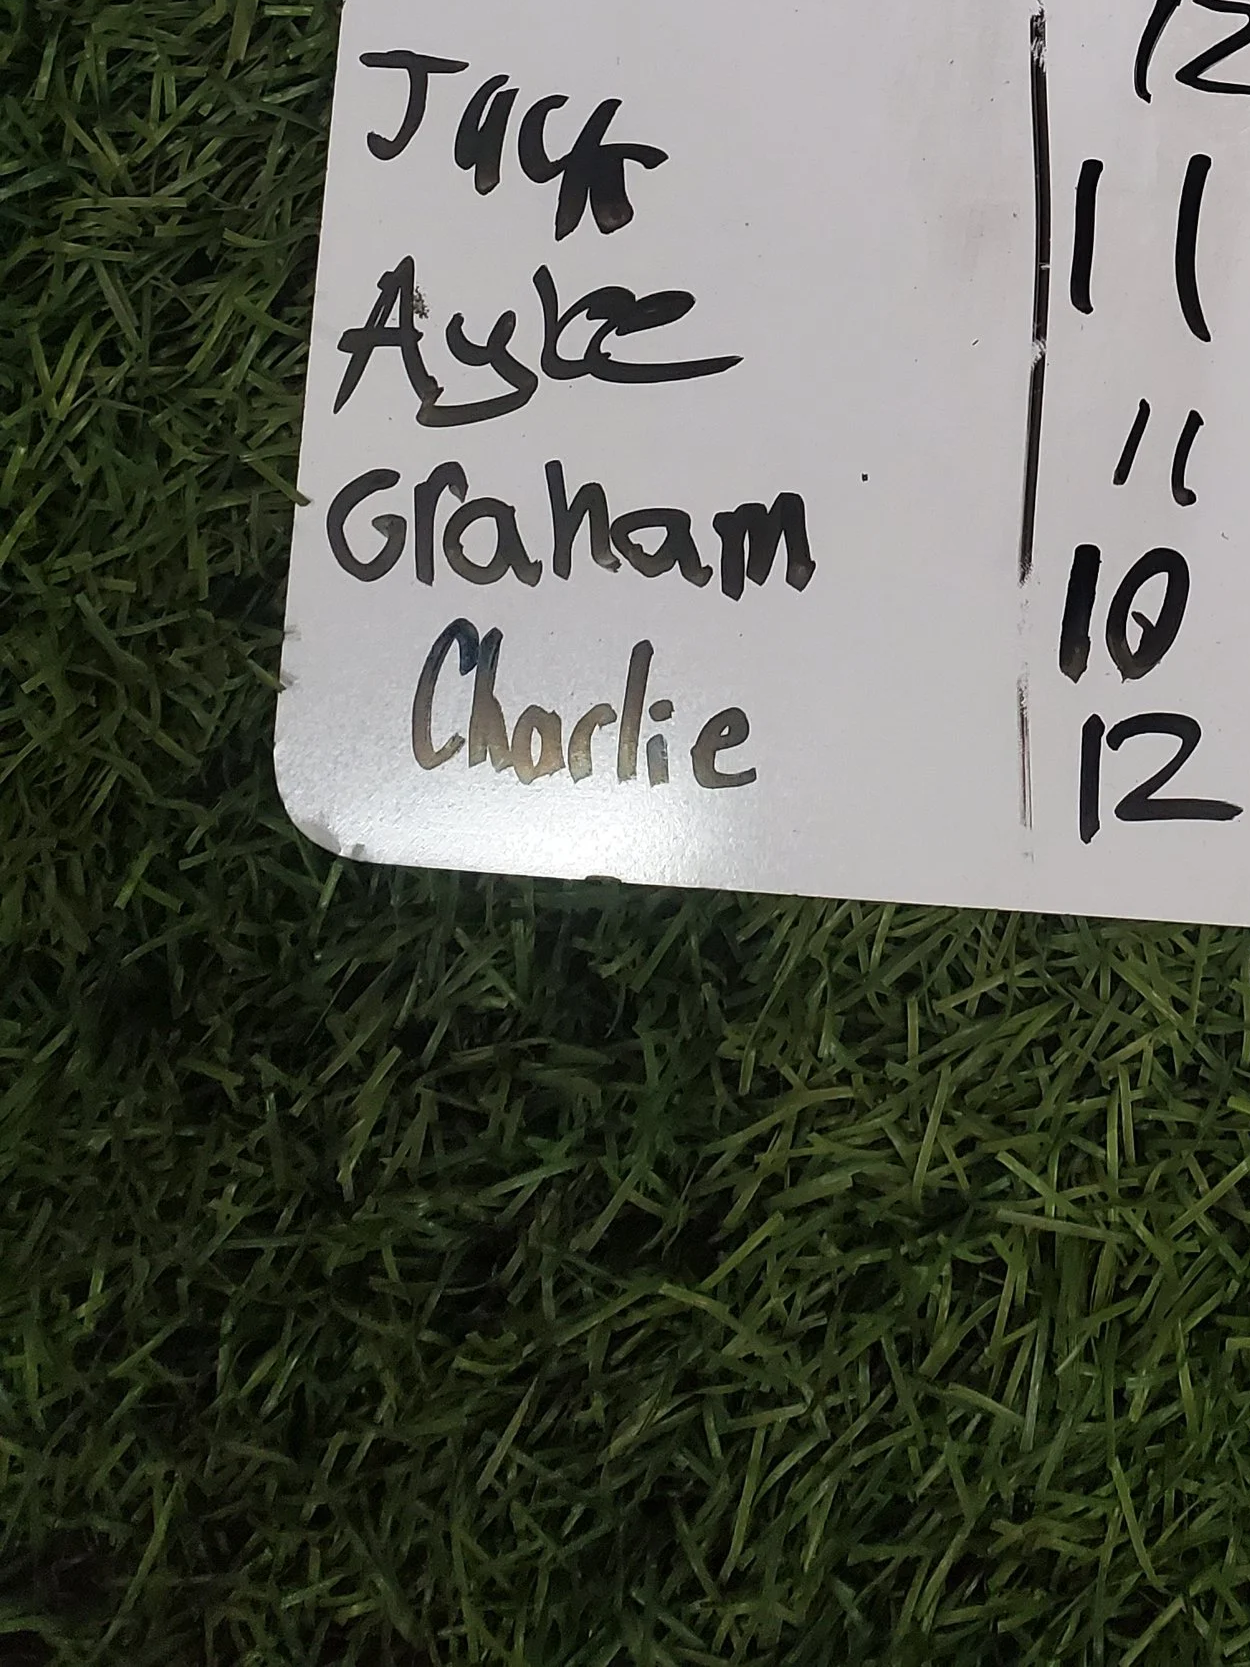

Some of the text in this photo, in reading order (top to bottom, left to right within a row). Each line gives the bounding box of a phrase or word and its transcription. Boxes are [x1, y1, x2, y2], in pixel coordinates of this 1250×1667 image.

[1069, 153, 1212, 343] 11
[1112, 398, 1205, 507] 11
[326, 459, 817, 602] Graham
[1058, 543, 1190, 684] 10
[411, 617, 759, 789] Charlie
[1079, 712, 1244, 845] 12
